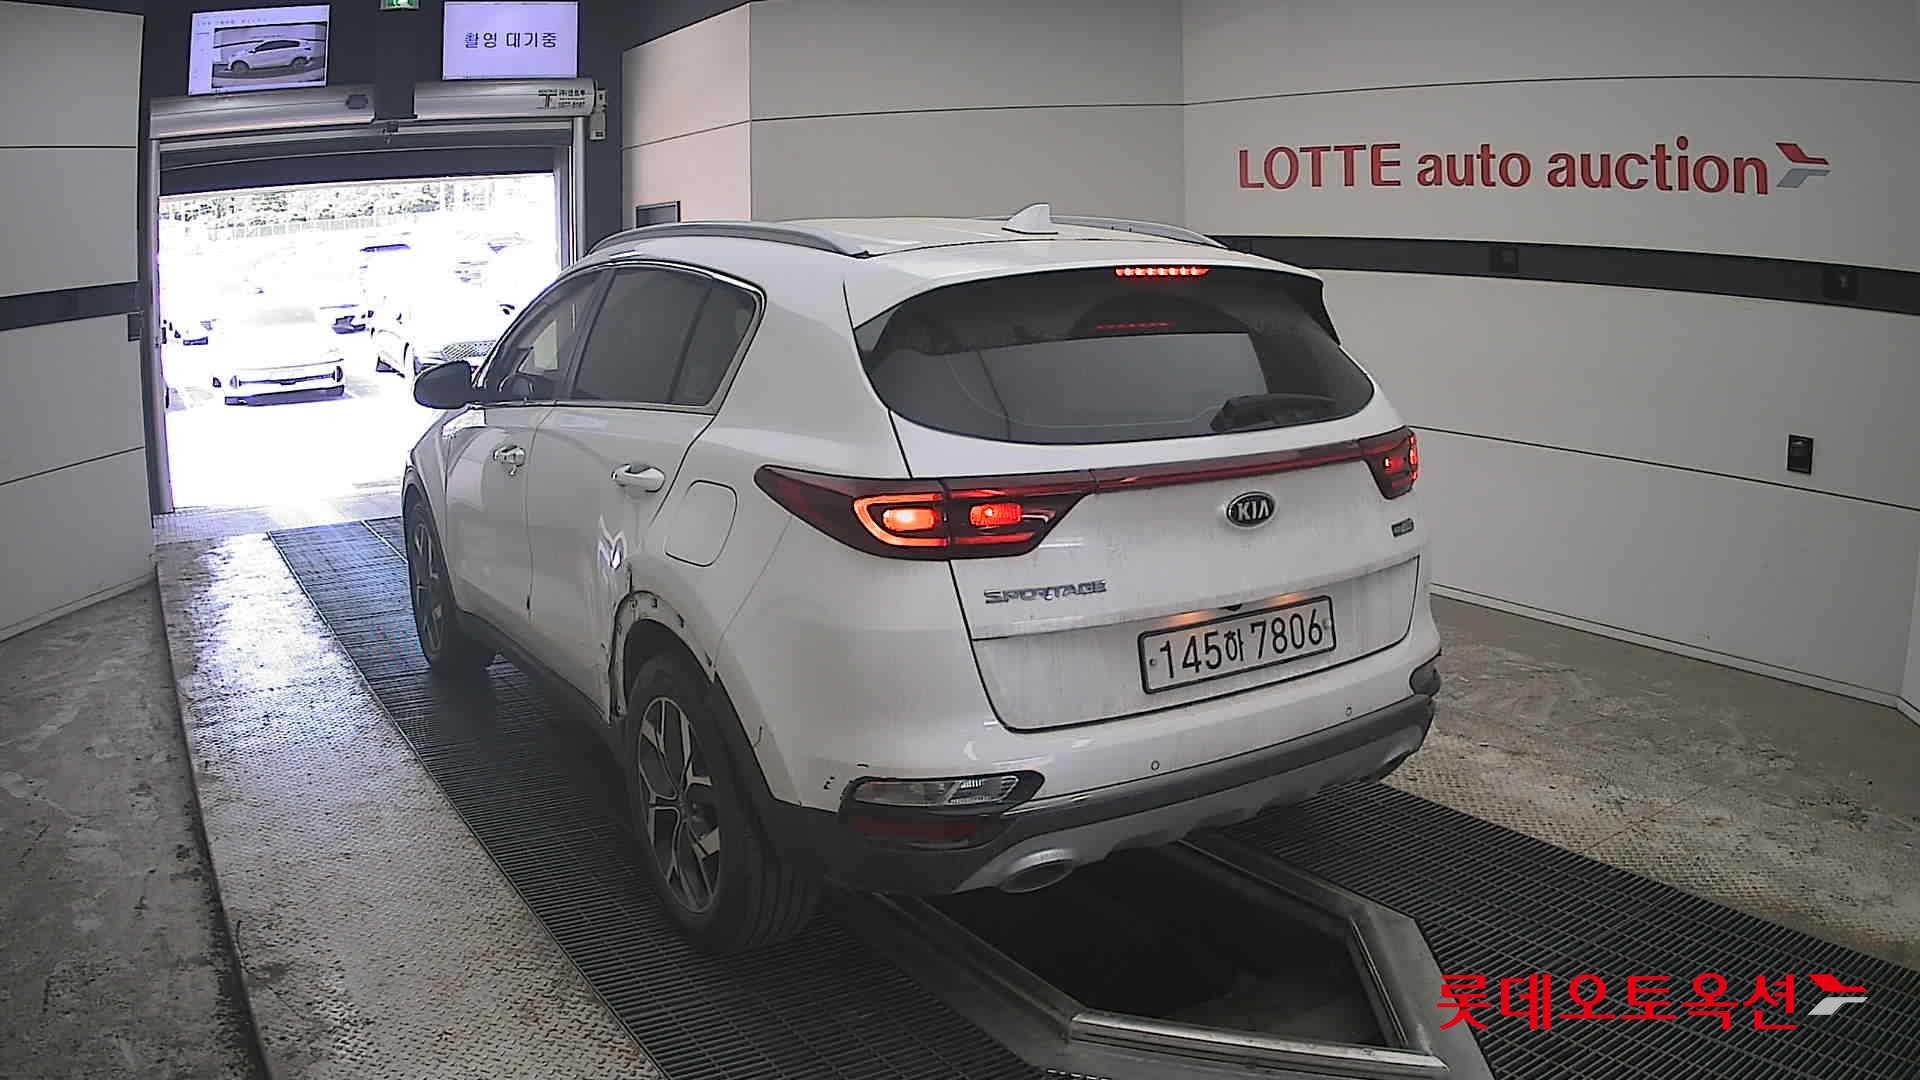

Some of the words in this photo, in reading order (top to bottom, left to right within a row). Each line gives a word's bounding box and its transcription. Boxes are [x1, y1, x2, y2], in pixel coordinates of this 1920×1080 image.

[505, 32, 558, 48] 대기중
[1239, 143, 1400, 189] LOTTE
[1417, 143, 1532, 188] auto
[1547, 136, 1769, 195] auction
[984, 579, 1107, 604] SPORTAGE
